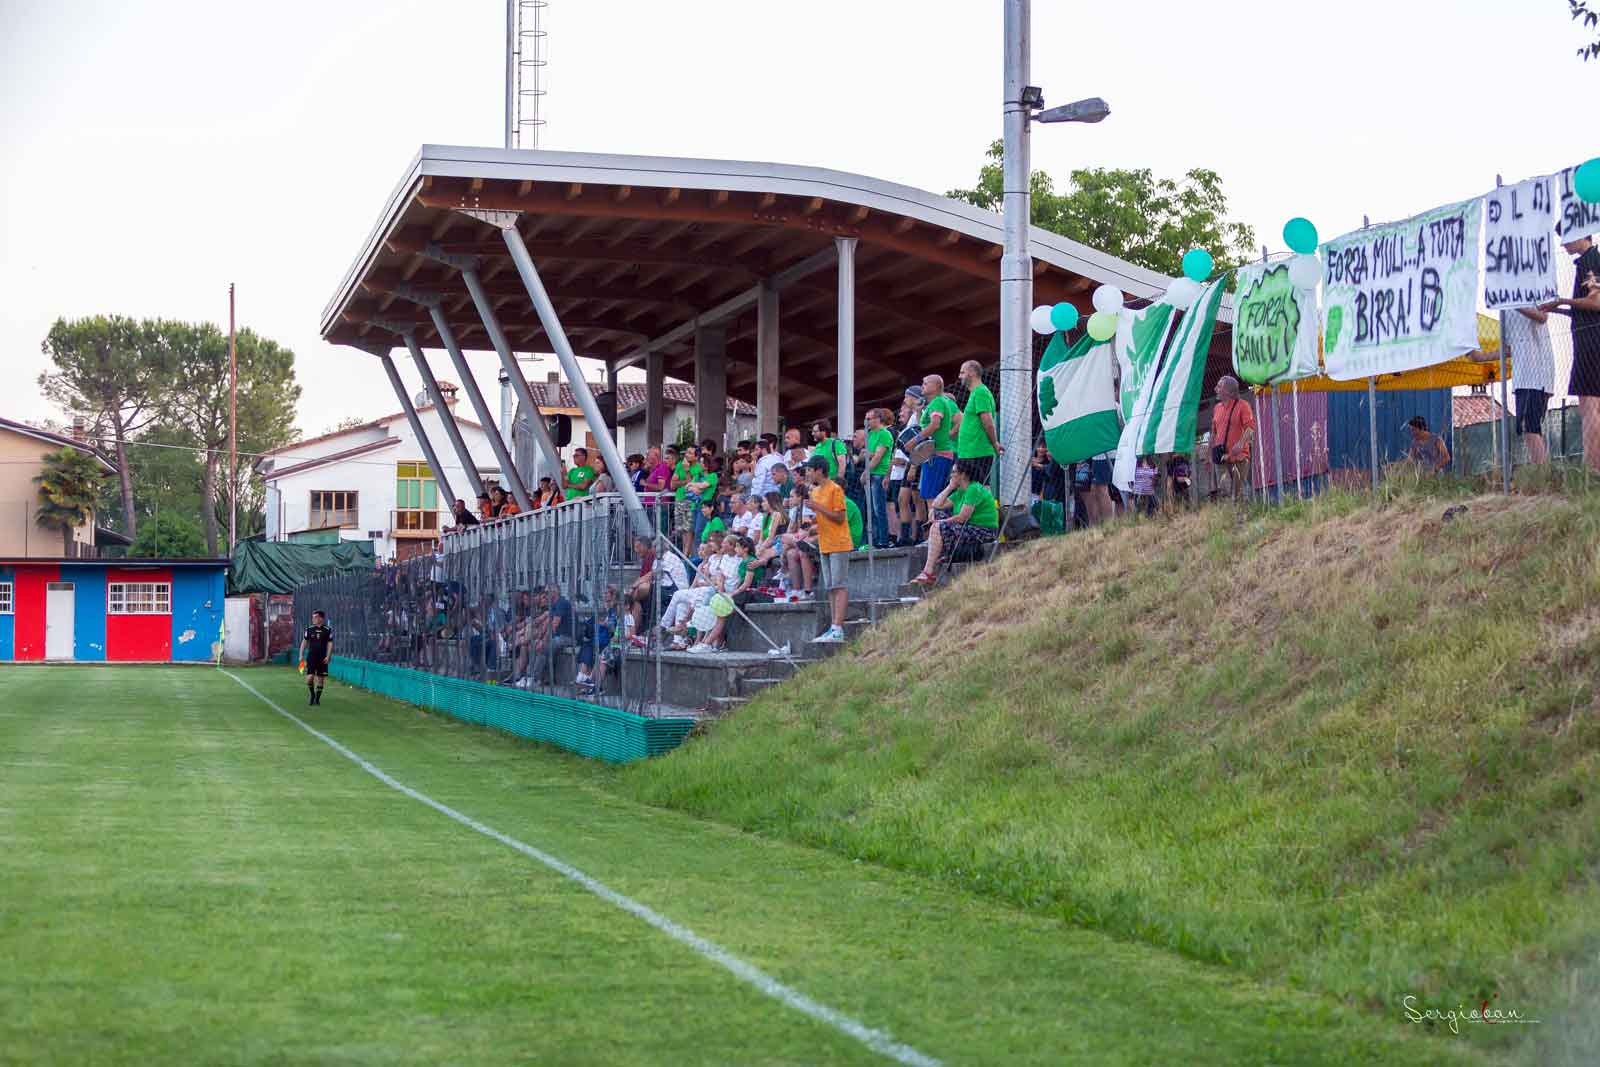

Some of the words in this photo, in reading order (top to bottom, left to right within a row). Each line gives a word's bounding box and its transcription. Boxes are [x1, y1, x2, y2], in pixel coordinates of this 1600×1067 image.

[1327, 244, 1369, 286] FORZA
[1429, 209, 1465, 261] TUTTA
[1245, 293, 1290, 330] FORZA
